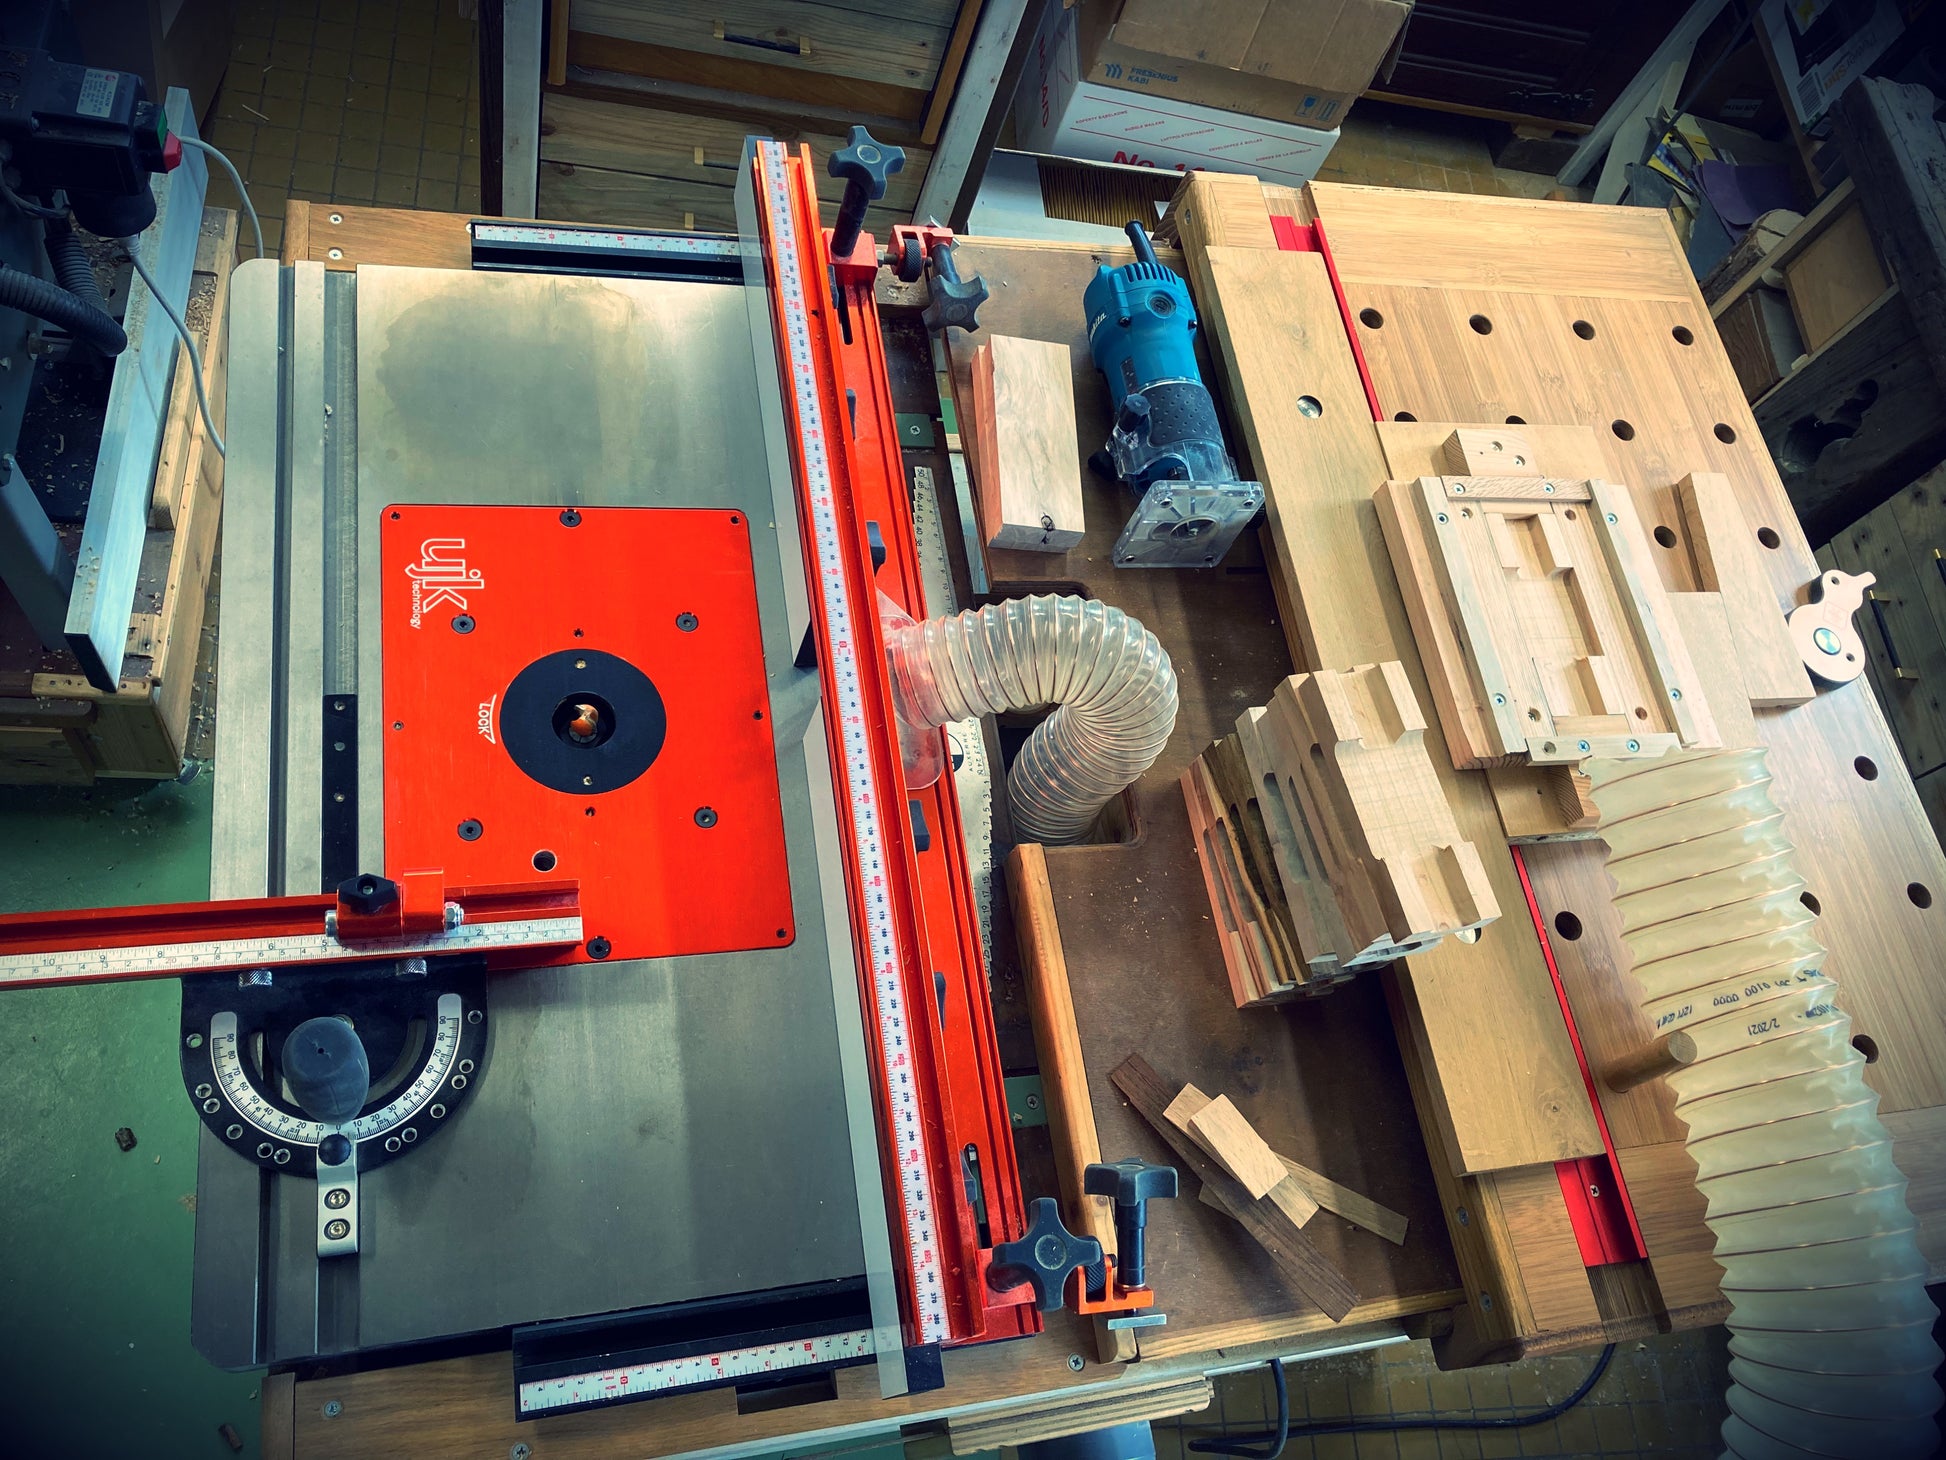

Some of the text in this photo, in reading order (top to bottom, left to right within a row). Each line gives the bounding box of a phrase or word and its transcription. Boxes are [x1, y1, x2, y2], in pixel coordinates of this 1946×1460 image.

[1127, 74, 1149, 85] KABI
[918, 468, 925, 478] 50
[918, 481, 925, 489] 48
[915, 514, 924, 523] 42
[916, 527, 923, 535] 40
[410, 579, 422, 630] technology
[478, 702, 491, 735] LOCK
[982, 861, 990, 870] 13
[982, 876, 990, 884] 15
[982, 906, 990, 914] 19
[982, 935, 990, 944] 23
[43, 958, 55, 967] 10
[99, 954, 106, 963] 9
[157, 950, 163, 958] 8
[268, 942, 274, 950] 6
[439, 1015, 447, 1025] 90
[1747, 1018, 1780, 1036] 2/2021
[226, 1033, 235, 1043] 90
[437, 1032, 446, 1042] 80
[228, 1050, 235, 1060] 80
[433, 1049, 441, 1058] 70
[232, 1067, 240, 1076] 70
[425, 1064, 434, 1074] 60
[239, 1081, 248, 1091] 60
[414, 1079, 424, 1089] 50
[250, 1095, 260, 1105] 50
[402, 1092, 412, 1102] 40
[263, 1107, 274, 1116] 40
[386, 1104, 397, 1113] 30
[280, 1115, 290, 1124] 30
[370, 1113, 380, 1122] 20
[296, 1121, 307, 1129] 20
[843, 1338, 849, 1346] 12
[860, 1335, 867, 1343] 13
